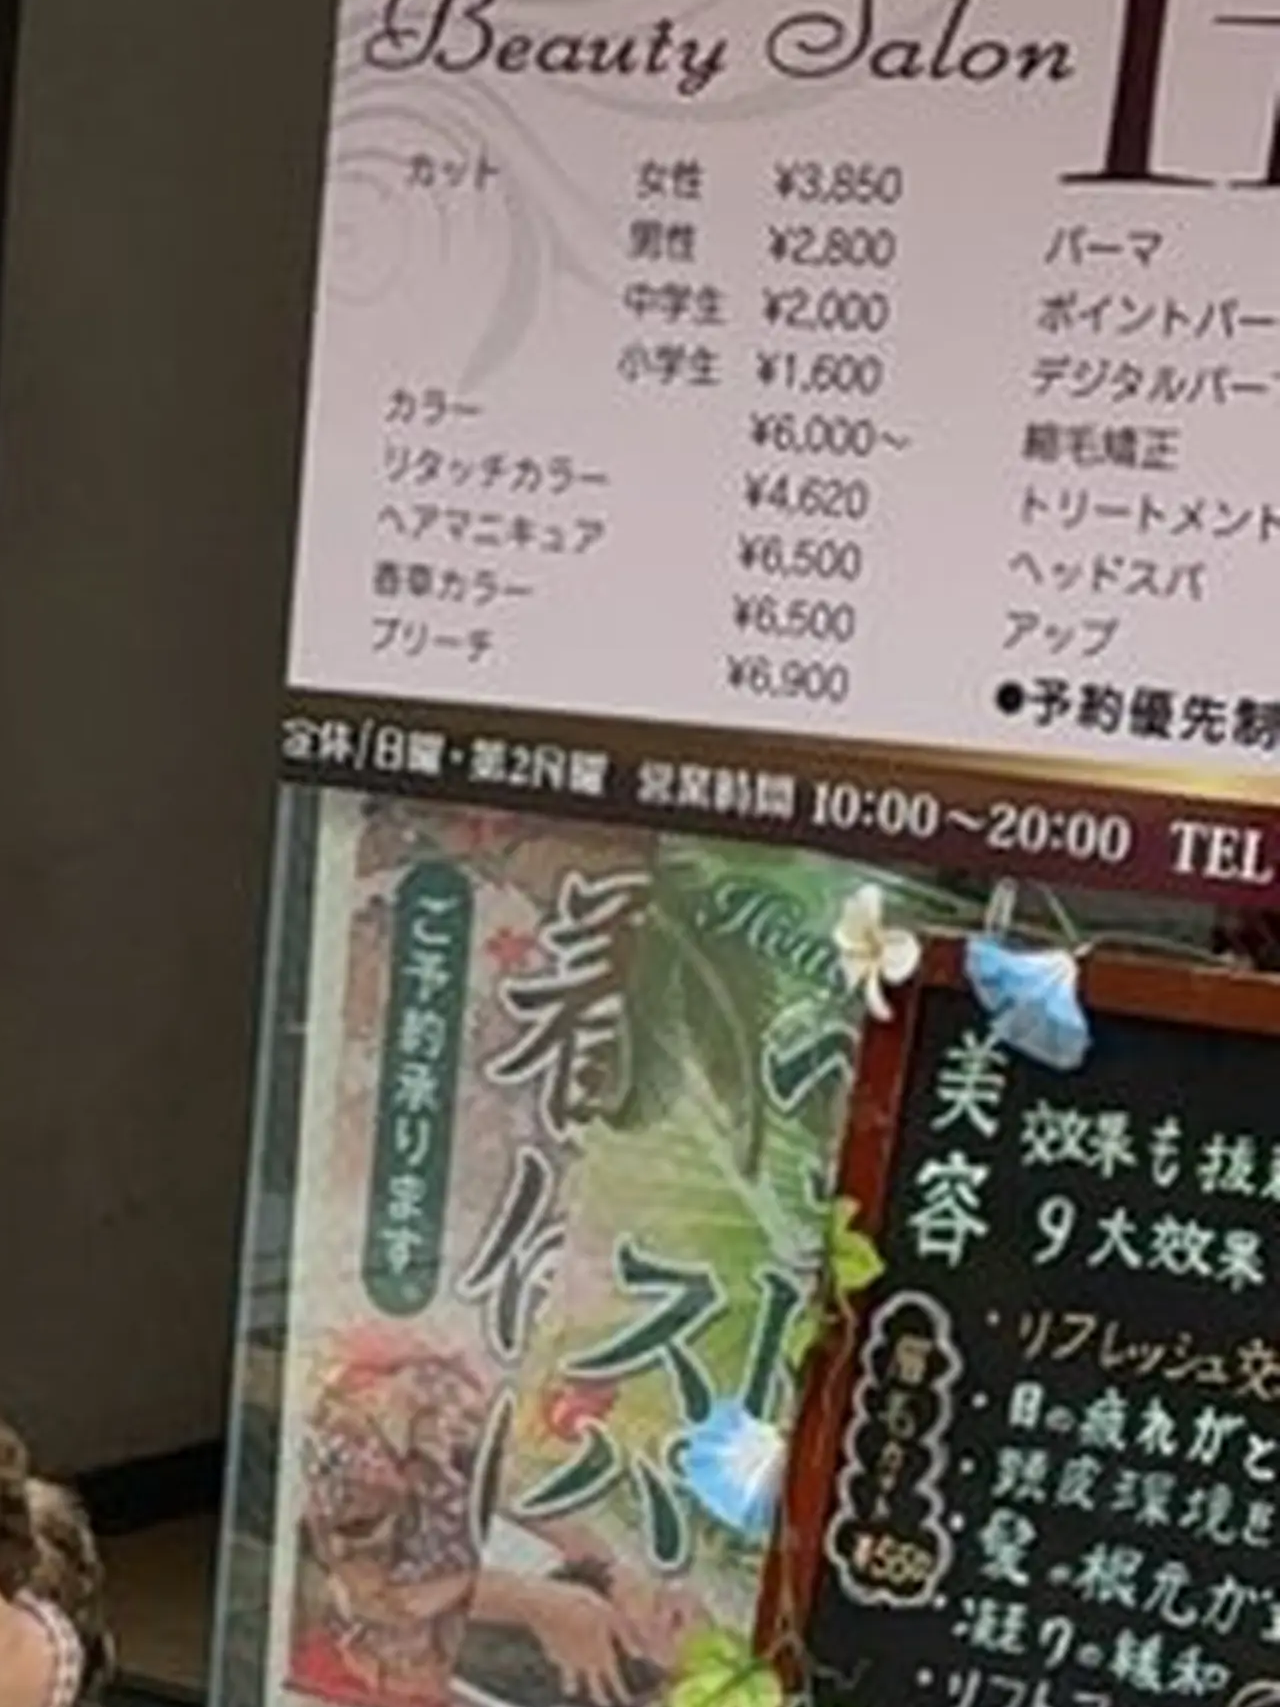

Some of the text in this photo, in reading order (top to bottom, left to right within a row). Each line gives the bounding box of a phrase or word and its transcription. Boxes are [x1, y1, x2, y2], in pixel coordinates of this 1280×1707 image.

[636, 159, 703, 200] 女性
[775, 161, 904, 205] ¥3,850
[627, 219, 897, 268] 男性 ¥2,800
[1045, 224, 1163, 267] パーマ
[621, 282, 890, 332] 中学生 ¥2,000
[616, 343, 884, 395] 小学生 ¥1,600
[1032, 355, 1280, 404] デジタルパー
[384, 388, 483, 426] カラー
[1022, 421, 1182, 471] 縮毛矯正
[384, 439, 870, 520] リタッチカラー ¥4,620
[1021, 485, 1280, 541] トリートメント
[376, 503, 863, 581] ヘアマニキュア ¥6,500
[1008, 550, 1207, 601] ヘッドスパ
[732, 591, 856, 643] ¥6,500
[1002, 609, 1119, 657] アップ
[372, 616, 850, 704] ブリーチ ¥6,900
[637, 759, 794, 820] 営業時間
[1170, 822, 1275, 885] TEL
[908, 1030, 1008, 1268] 美容
[1019, 1101, 1280, 1202] 効果も抜
